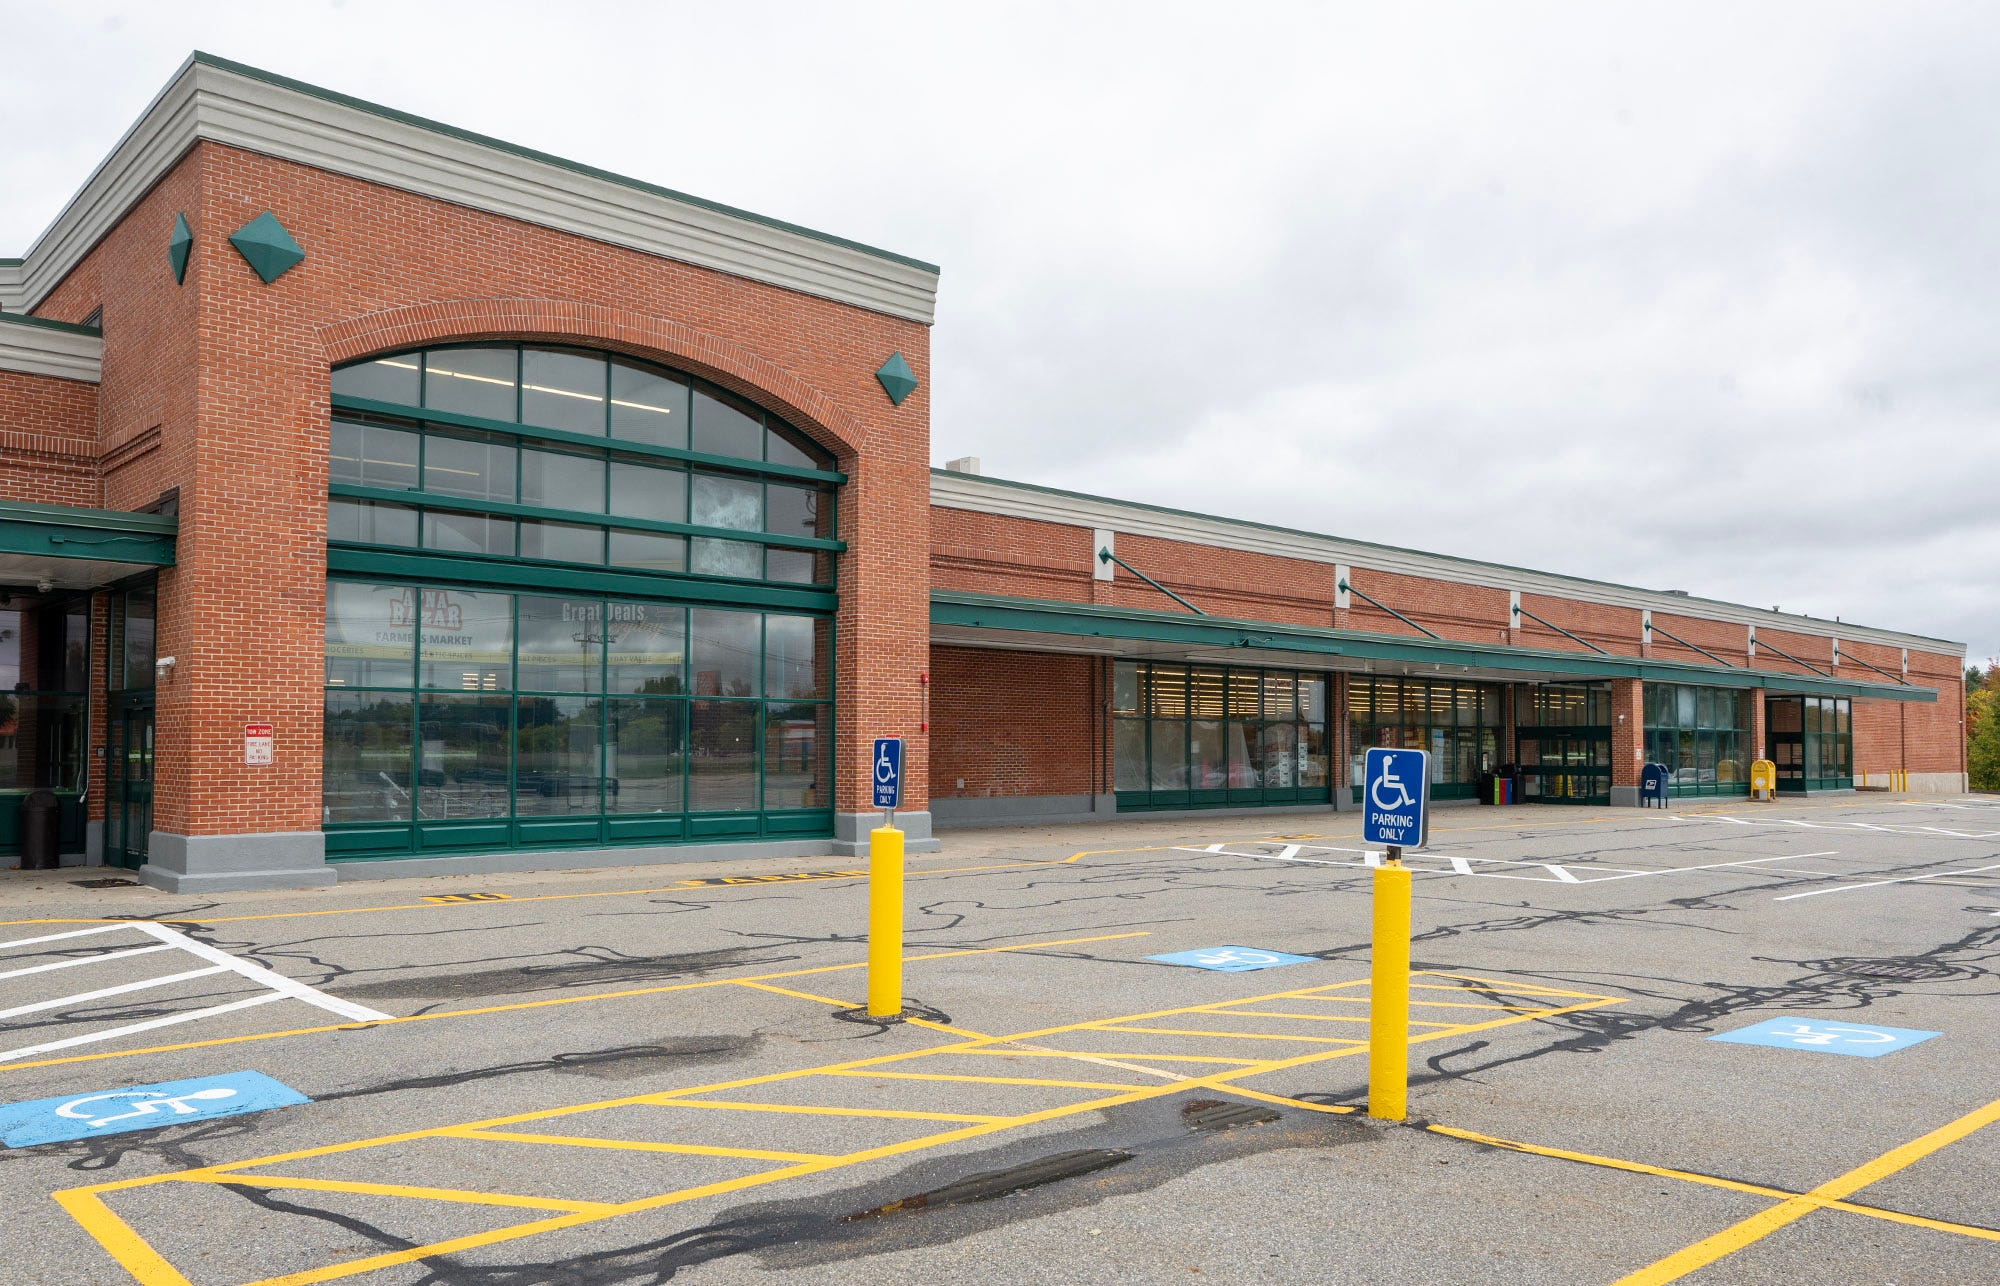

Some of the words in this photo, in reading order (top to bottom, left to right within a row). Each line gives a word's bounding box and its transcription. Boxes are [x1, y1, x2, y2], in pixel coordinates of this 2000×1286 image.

[403, 590, 447, 609] ANA
[562, 602, 600, 622] Great
[375, 631, 427, 644] FARMES
[430, 634, 473, 646] MARKET
[876, 785, 895, 795] PARKING
[879, 795, 891, 804] ONLY
[1372, 812, 1413, 828] PARKING
[1379, 827, 1405, 840] ONLY
